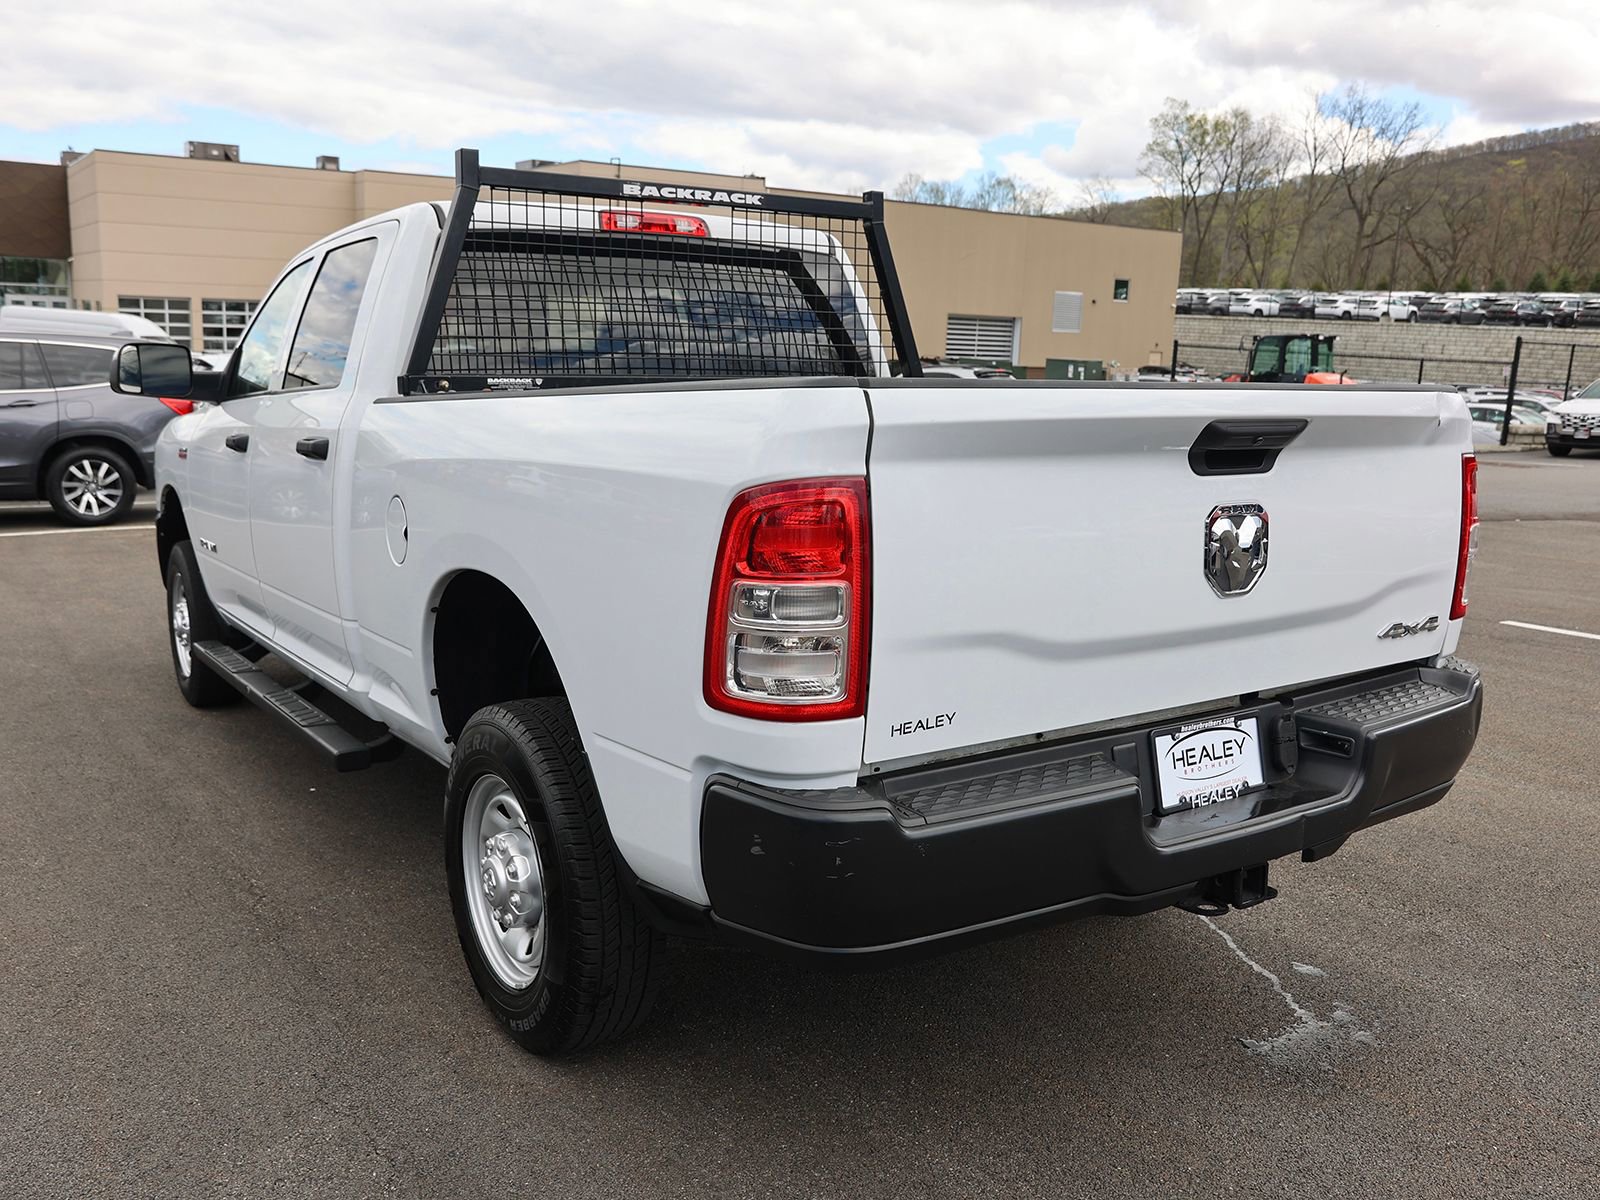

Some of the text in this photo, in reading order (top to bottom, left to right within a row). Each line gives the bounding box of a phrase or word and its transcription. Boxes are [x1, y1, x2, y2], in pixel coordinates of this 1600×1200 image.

[622, 182, 763, 206] BACKRACK
[487, 378, 533, 386] BACKRACK
[1218, 504, 1259, 515] RAM
[890, 711, 957, 738] HEALEY
[1181, 717, 1235, 732] healeybrothers.com
[1171, 736, 1246, 770] HEALEY
[1183, 758, 1235, 776] BROTHERS
[1191, 784, 1241, 809] HEALEY
[509, 986, 552, 1032] GRABBER
